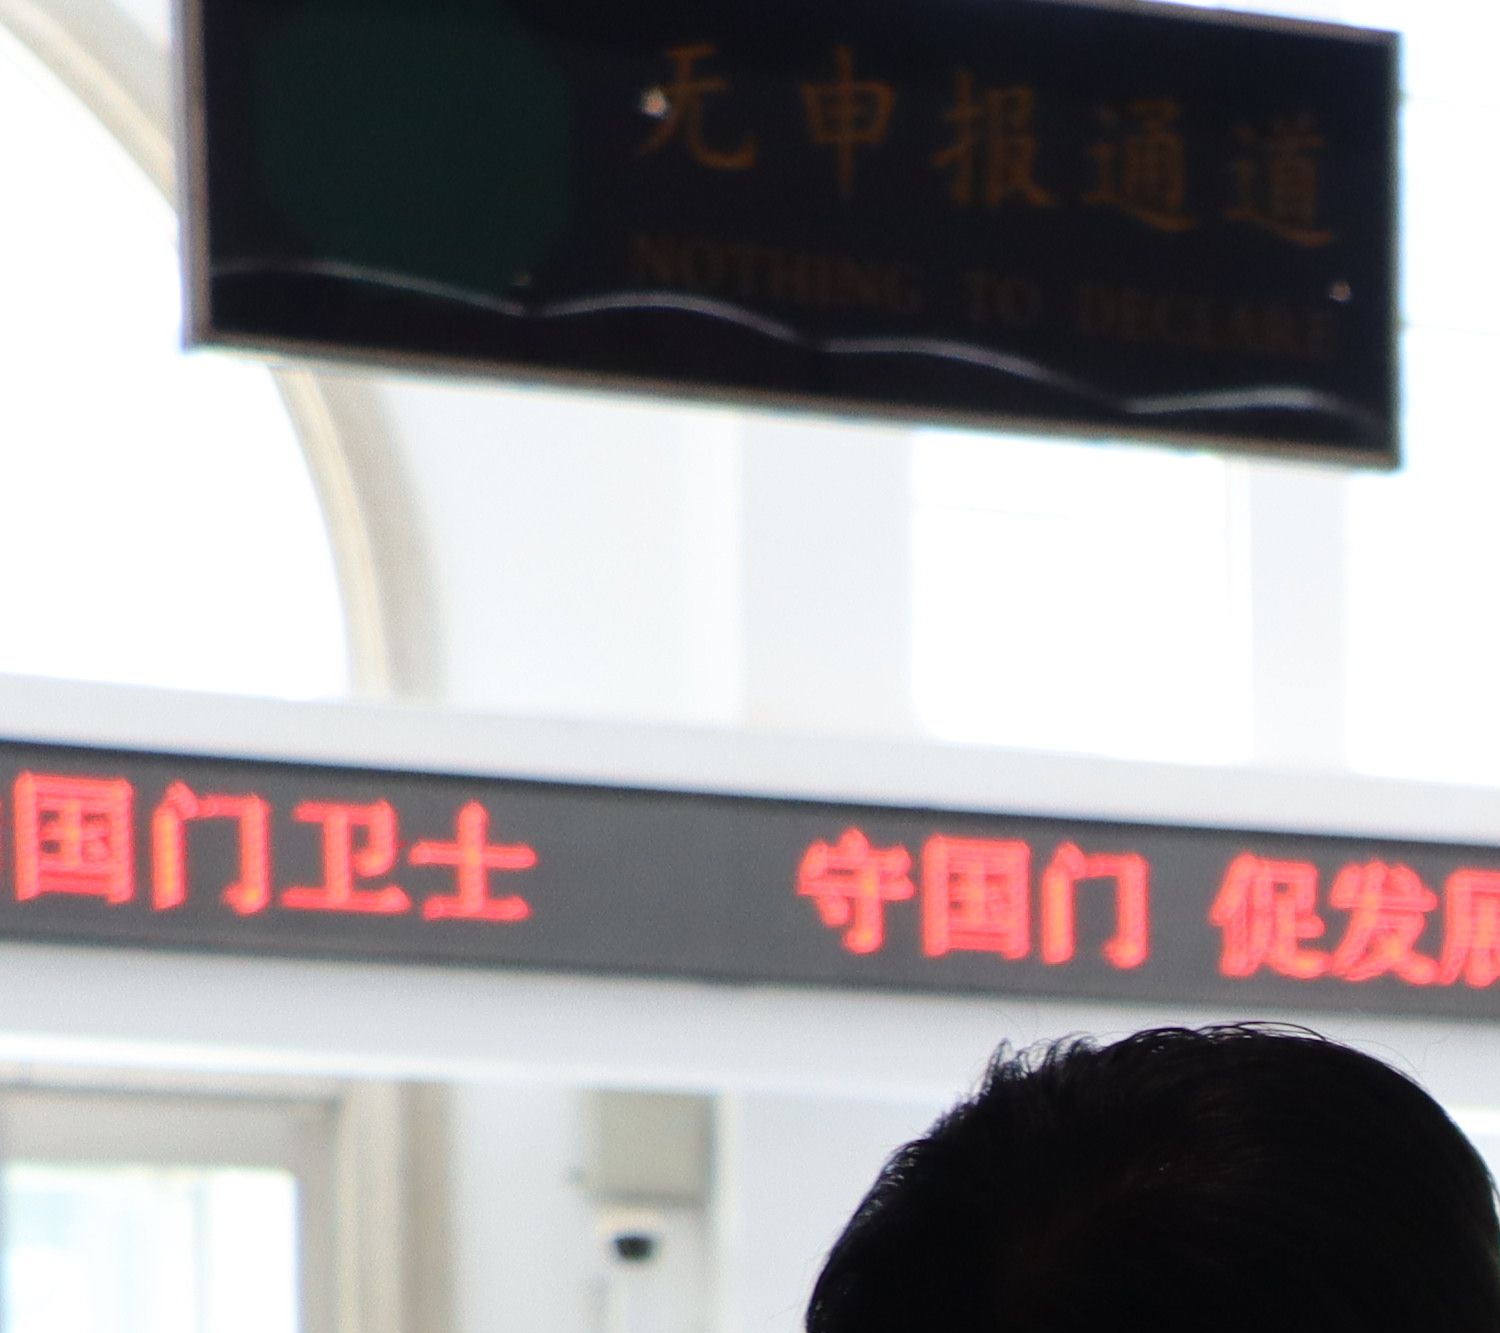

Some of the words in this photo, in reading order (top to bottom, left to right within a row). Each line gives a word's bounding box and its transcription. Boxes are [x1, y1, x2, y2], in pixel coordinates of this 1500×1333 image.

[632, 42, 1337, 250] 无申报通道
[625, 231, 924, 316] NOTHING
[963, 268, 1040, 328] TO
[1075, 281, 1339, 362] DECLARE
[12, 770, 538, 922] 国门卫士
[796, 827, 1151, 972] 守国门
